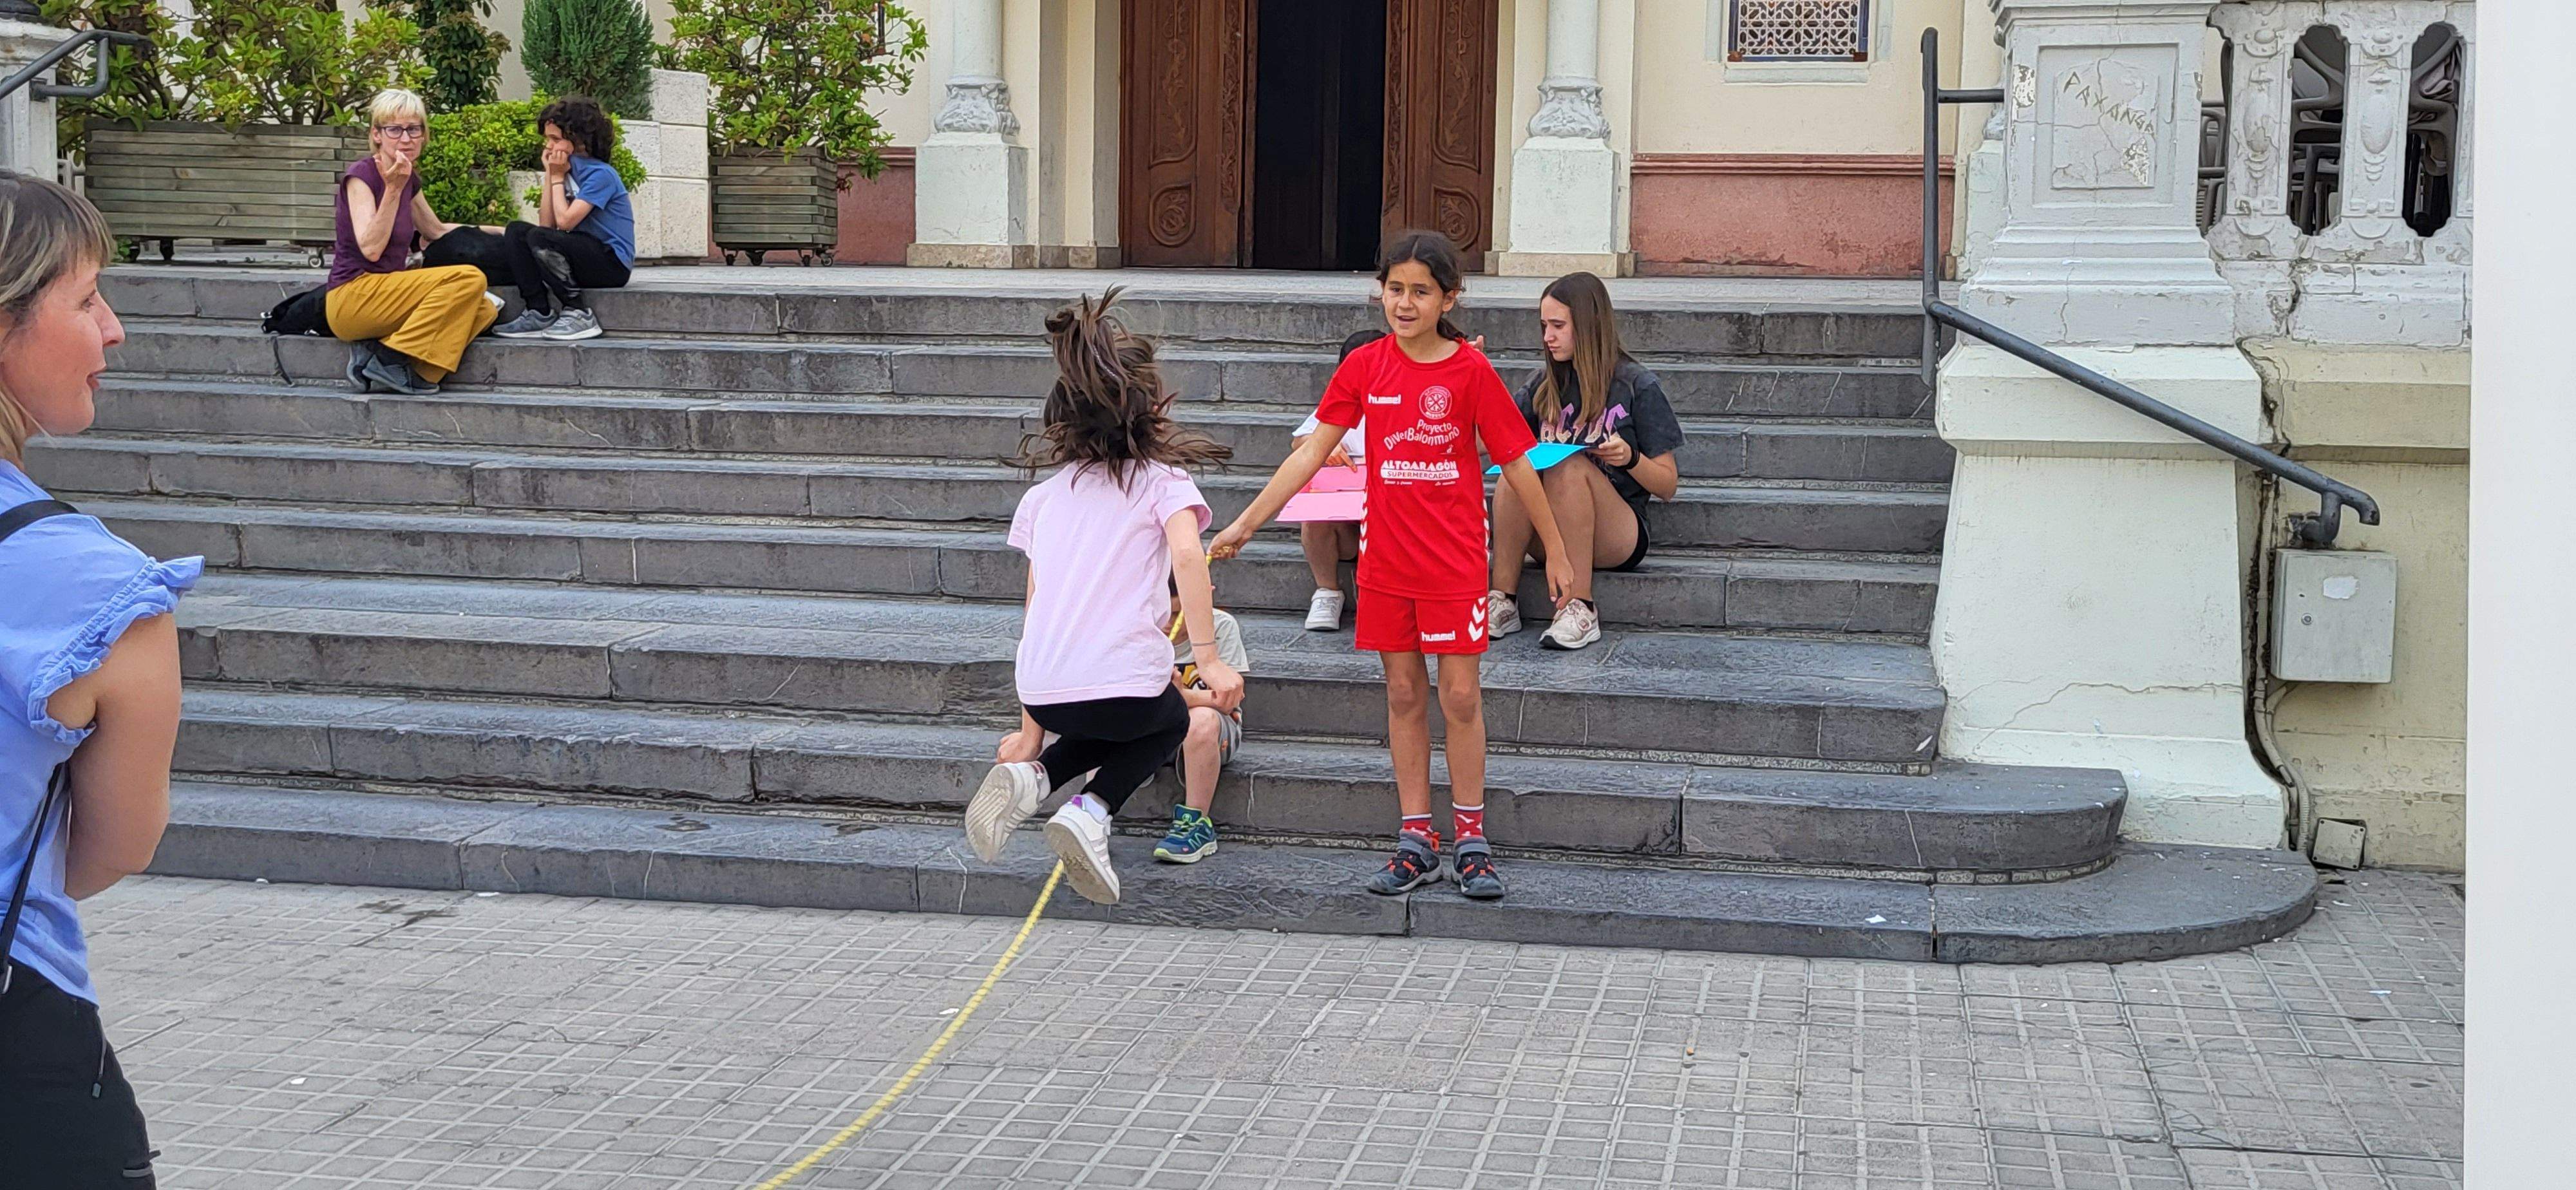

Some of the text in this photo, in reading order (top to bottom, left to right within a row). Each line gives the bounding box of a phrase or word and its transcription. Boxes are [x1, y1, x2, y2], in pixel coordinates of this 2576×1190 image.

[1416, 419, 1452, 435] Proyecto
[1381, 458, 1457, 471] ALTOARAGÓN
[1387, 471, 1454, 479] SUPERMERCADOS
